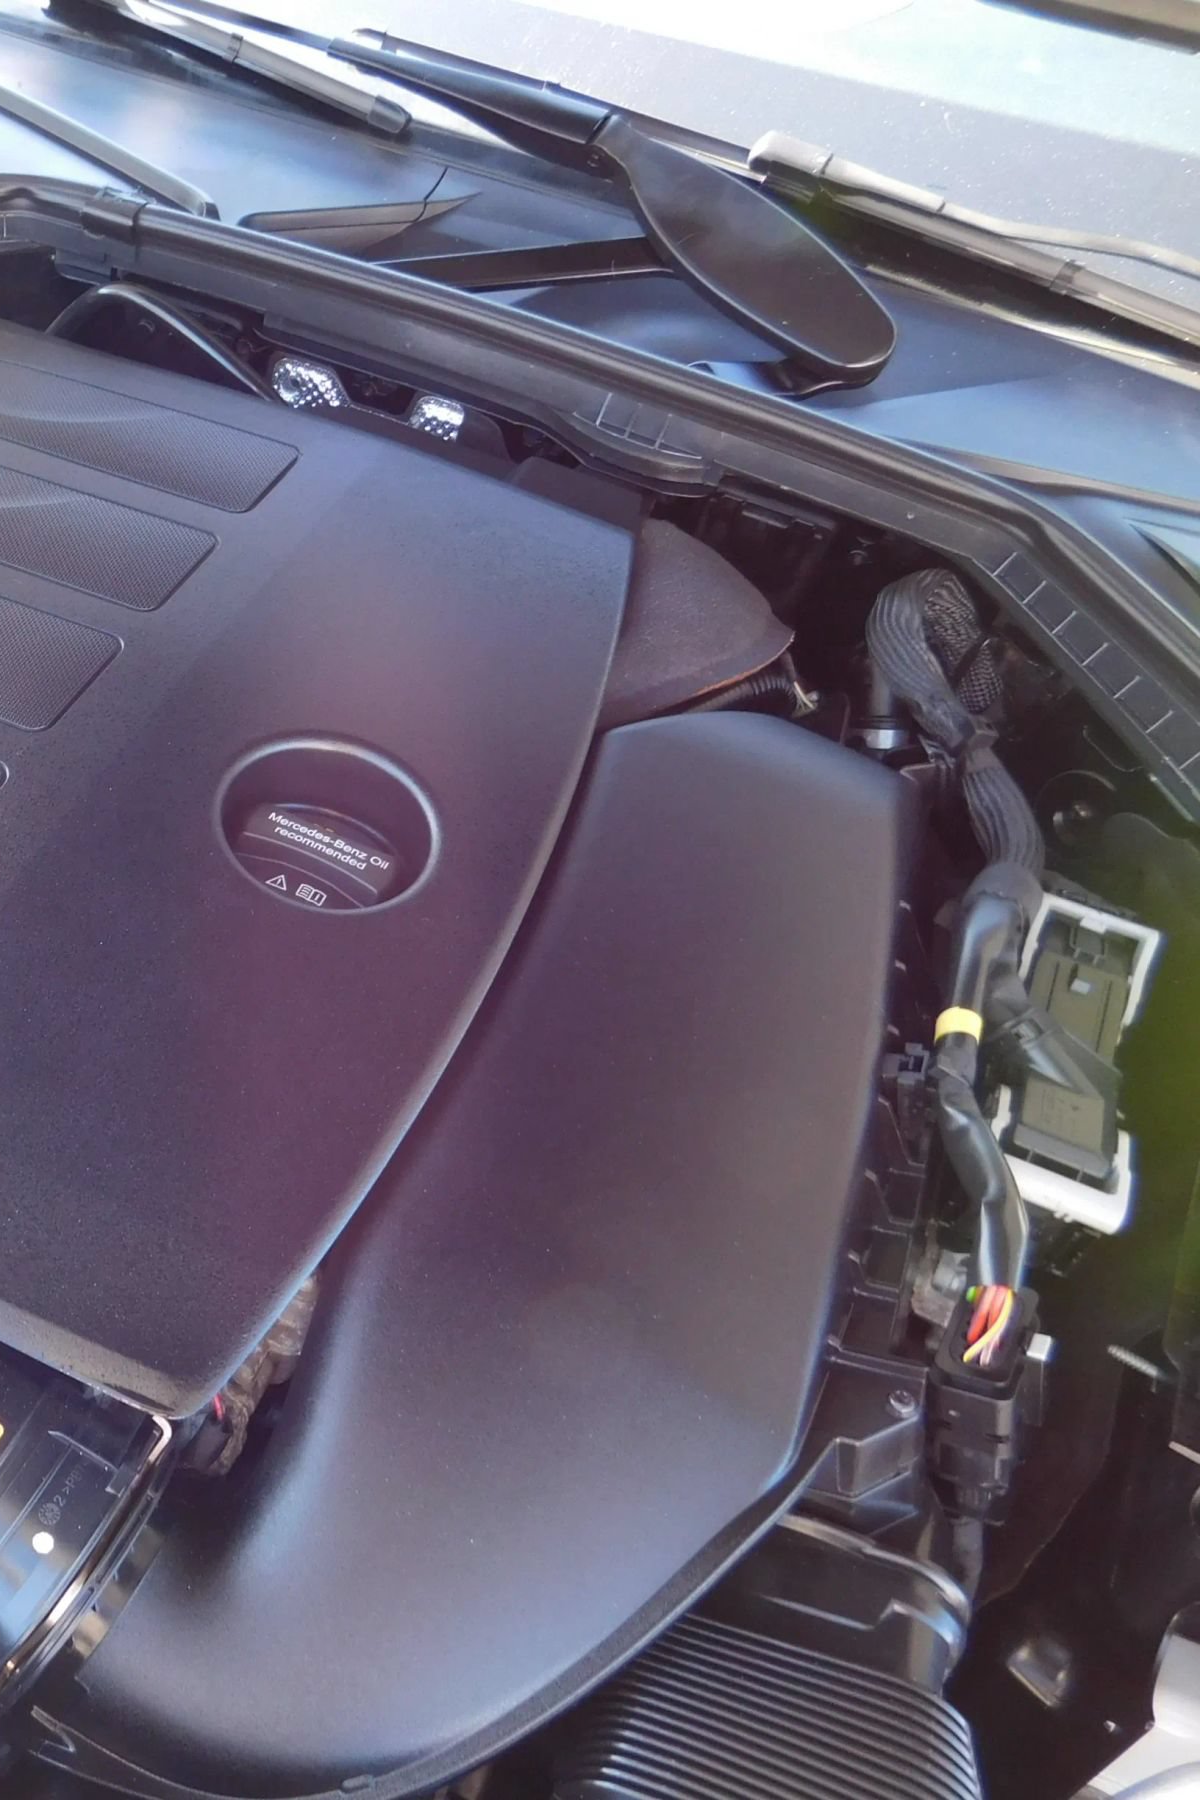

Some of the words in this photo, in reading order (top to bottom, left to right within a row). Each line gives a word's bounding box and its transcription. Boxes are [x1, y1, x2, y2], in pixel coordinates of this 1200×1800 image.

[268, 812, 368, 860] Mercedes-Benz
[370, 856, 390, 870] Oil
[274, 826, 367, 870] recommended
